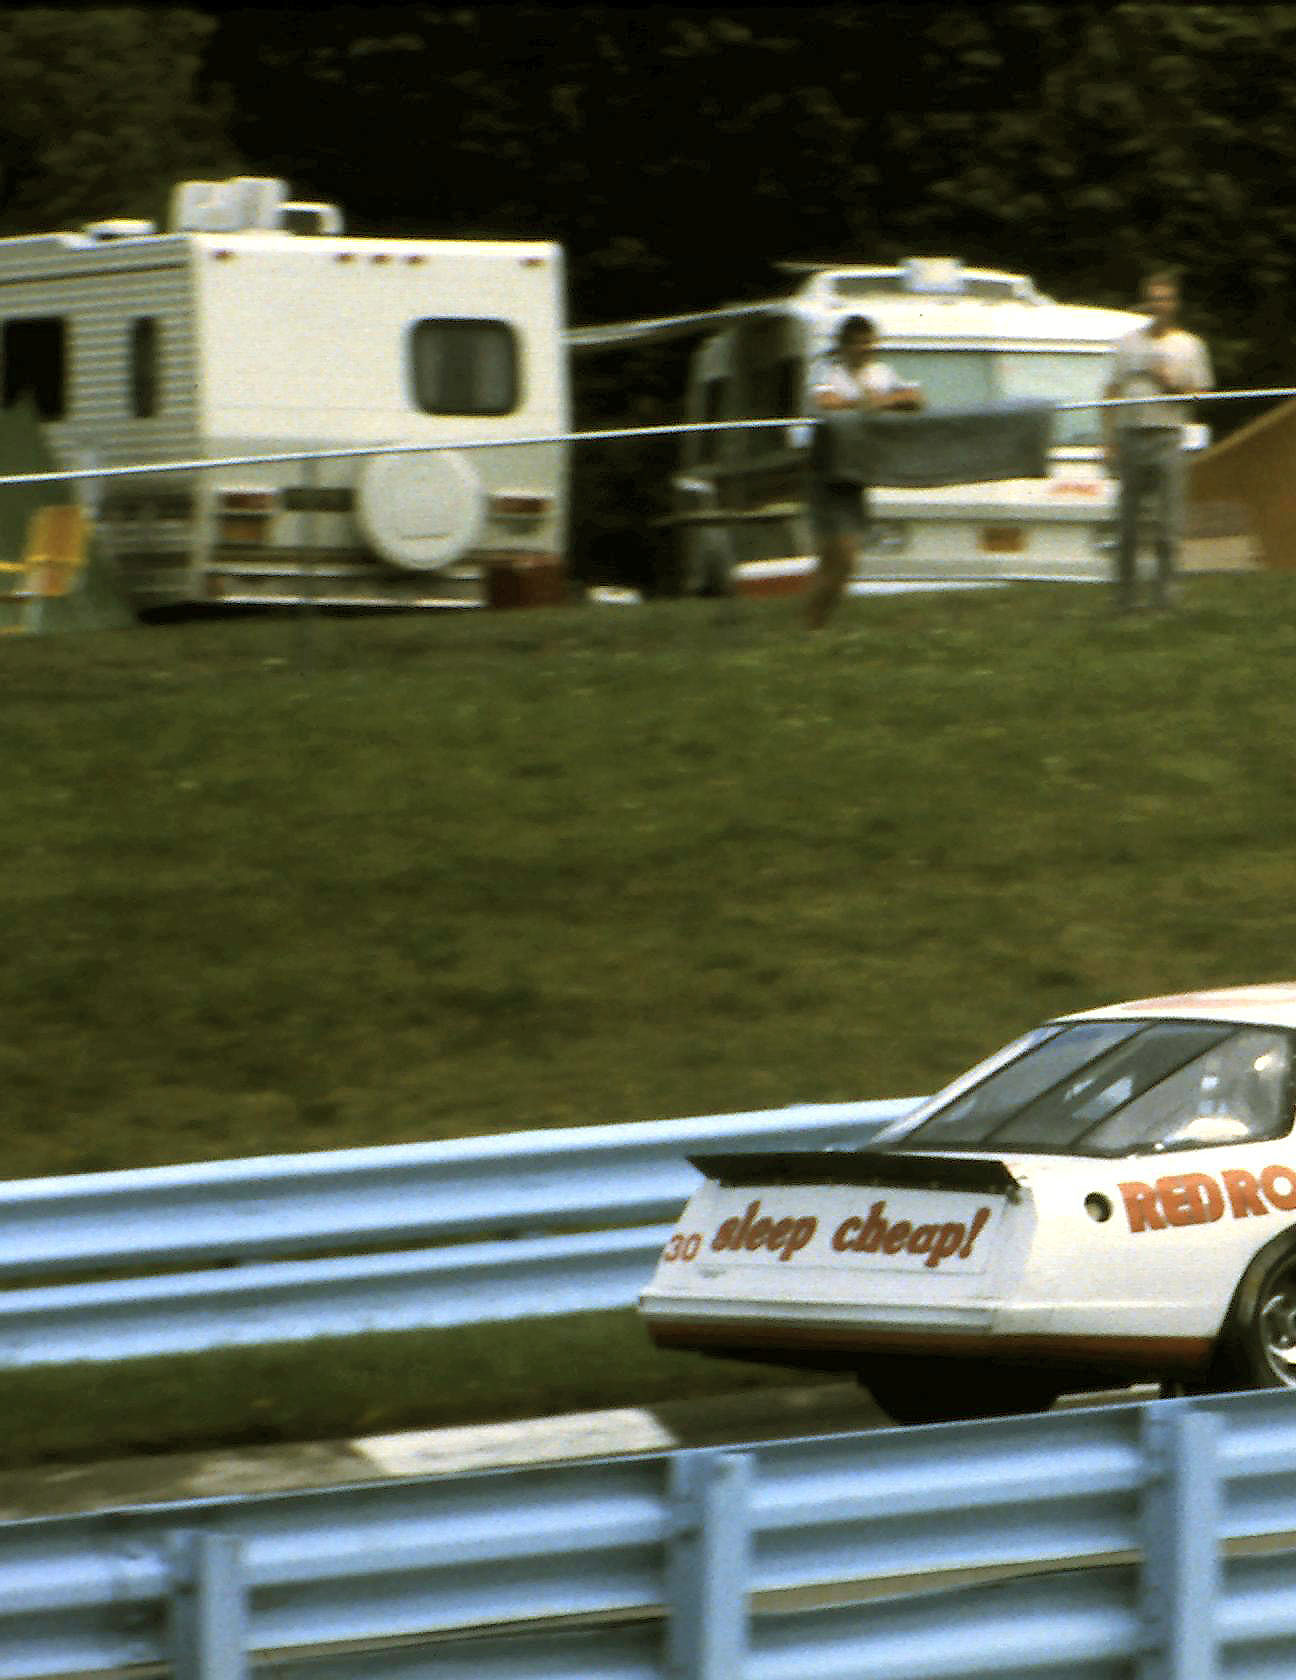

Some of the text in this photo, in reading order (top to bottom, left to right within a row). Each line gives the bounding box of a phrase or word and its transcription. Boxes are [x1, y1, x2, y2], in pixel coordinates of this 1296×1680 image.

[1117, 1173, 1225, 1233] RED
[664, 1232, 703, 1262] 30
[712, 1199, 992, 1268] sleep cheap!
